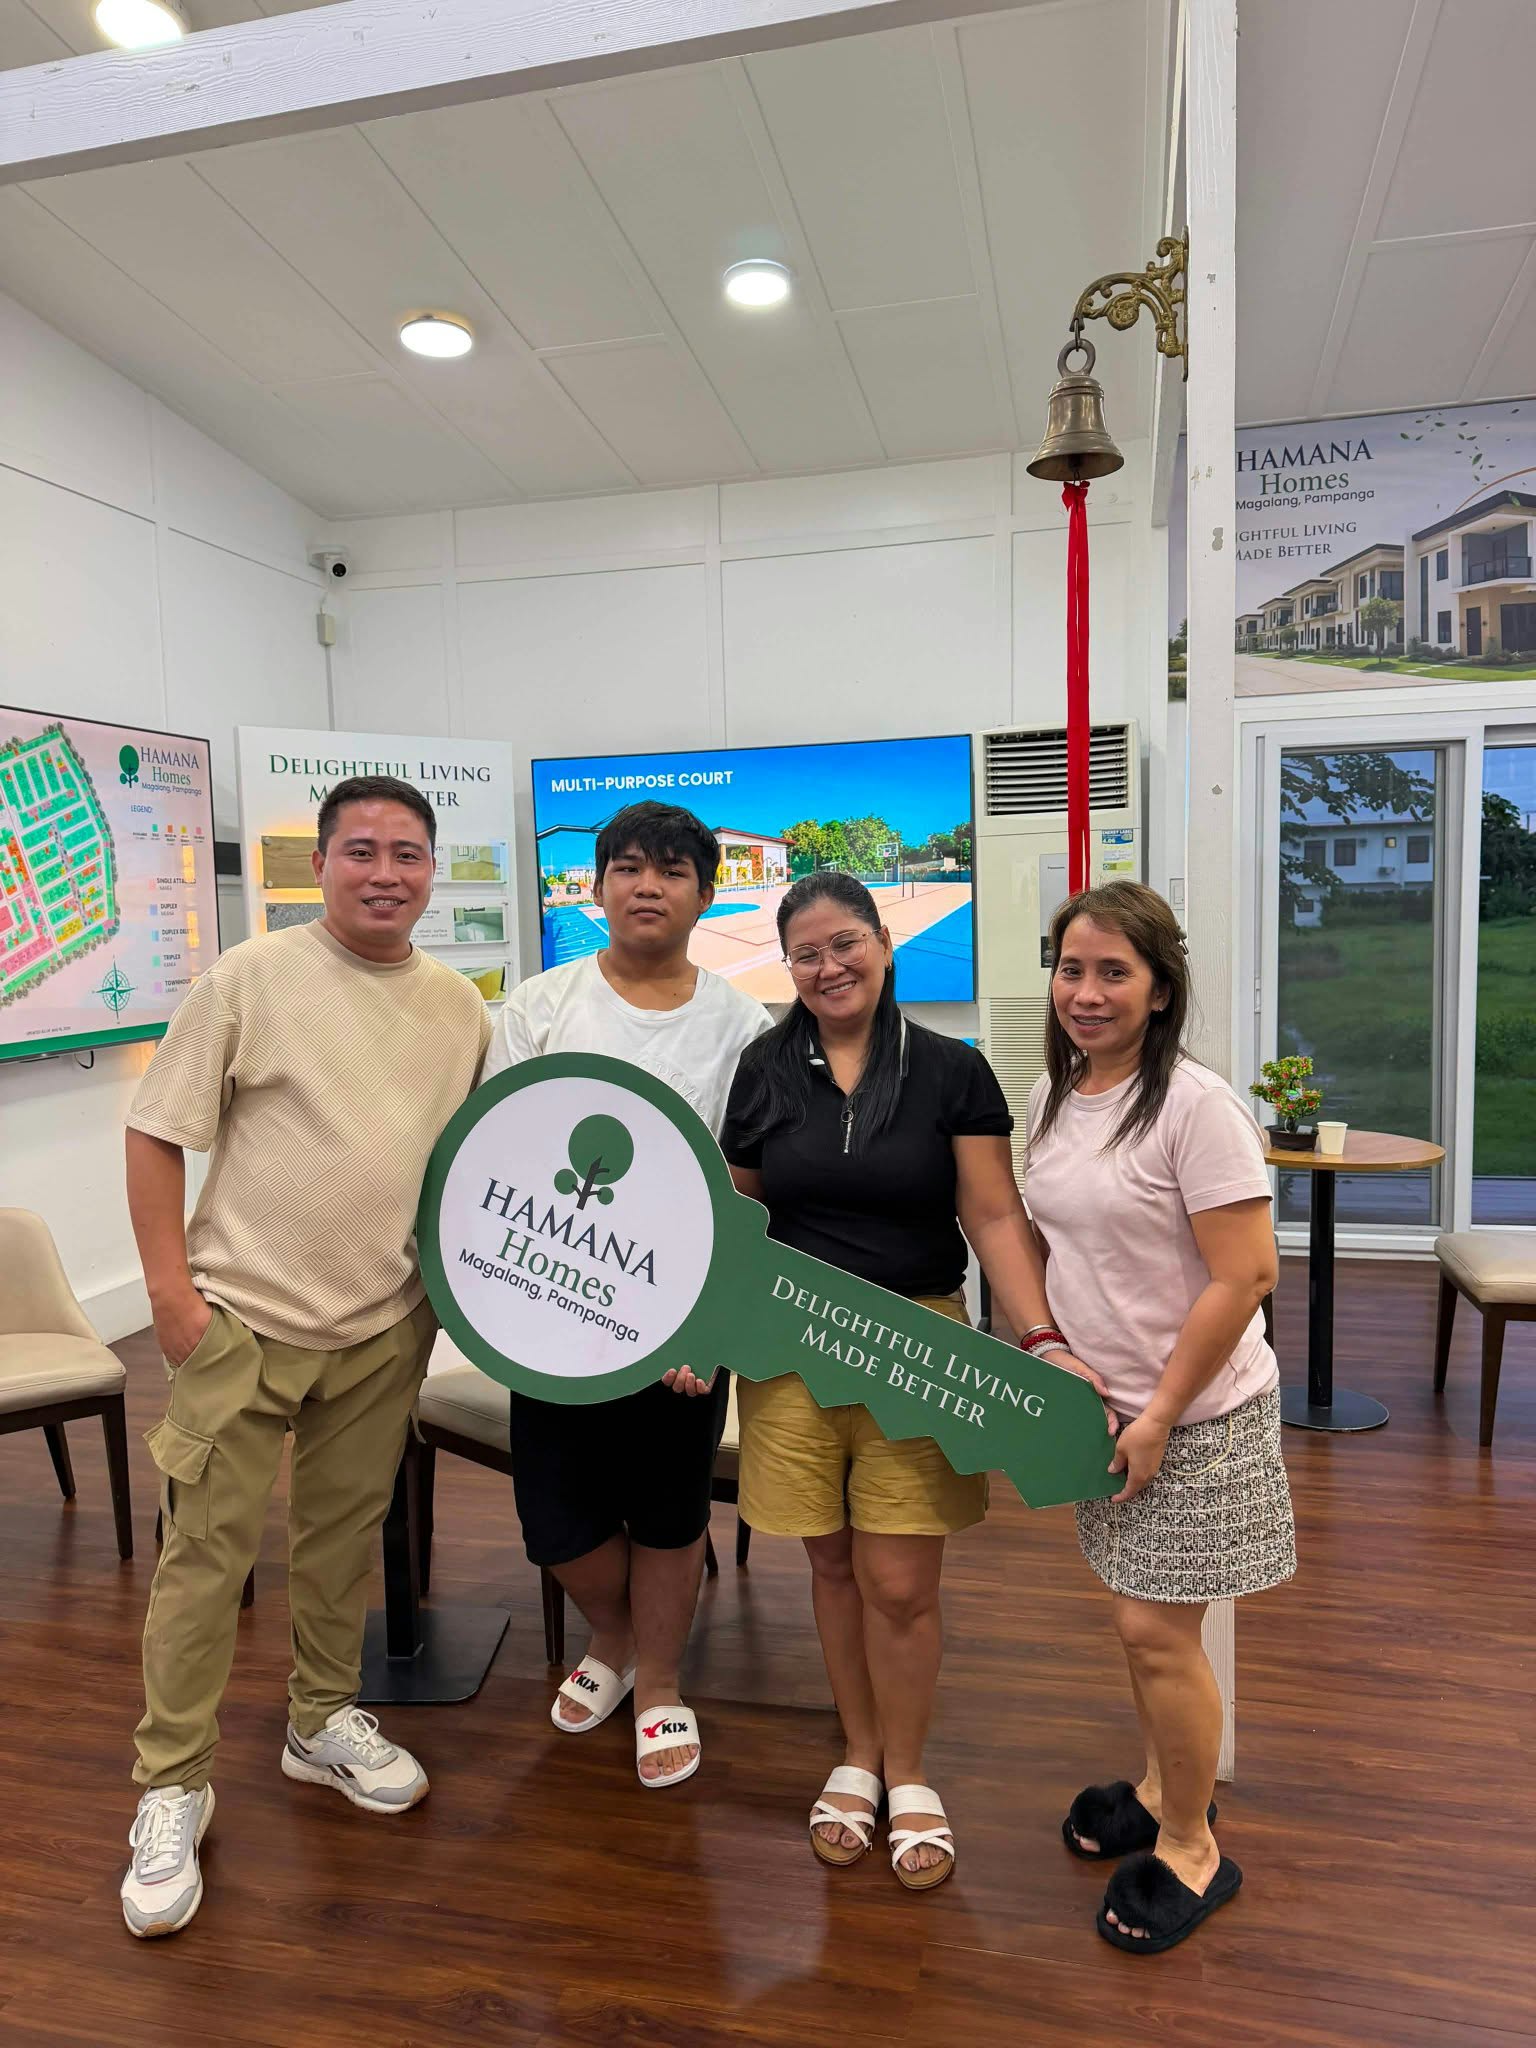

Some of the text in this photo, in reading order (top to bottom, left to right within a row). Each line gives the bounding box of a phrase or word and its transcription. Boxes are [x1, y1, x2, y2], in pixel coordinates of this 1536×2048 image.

[1236, 438, 1374, 472] HAMANA
[1260, 472, 1349, 495] Homes
[1236, 490, 1375, 511] Magalang, Pampanga
[1304, 522, 1357, 537] LIVING
[1278, 543, 1332, 557] BETTER
[140, 746, 200, 769] HAMANA
[152, 766, 191, 785] Homes
[420, 762, 490, 782] LIVING
[551, 771, 733, 792] MULTI-PURPOSE COURT
[479, 1177, 657, 1286] HAMANA
[496, 1227, 616, 1307] Homes
[459, 1248, 639, 1342] Magalang, Pampanga
[770, 1274, 1045, 1417] DELIGHTFUL LIVING
[800, 1323, 985, 1428] MADE BETTER
[576, 1674, 600, 1693] KIX
[661, 1722, 688, 1735] KIX
